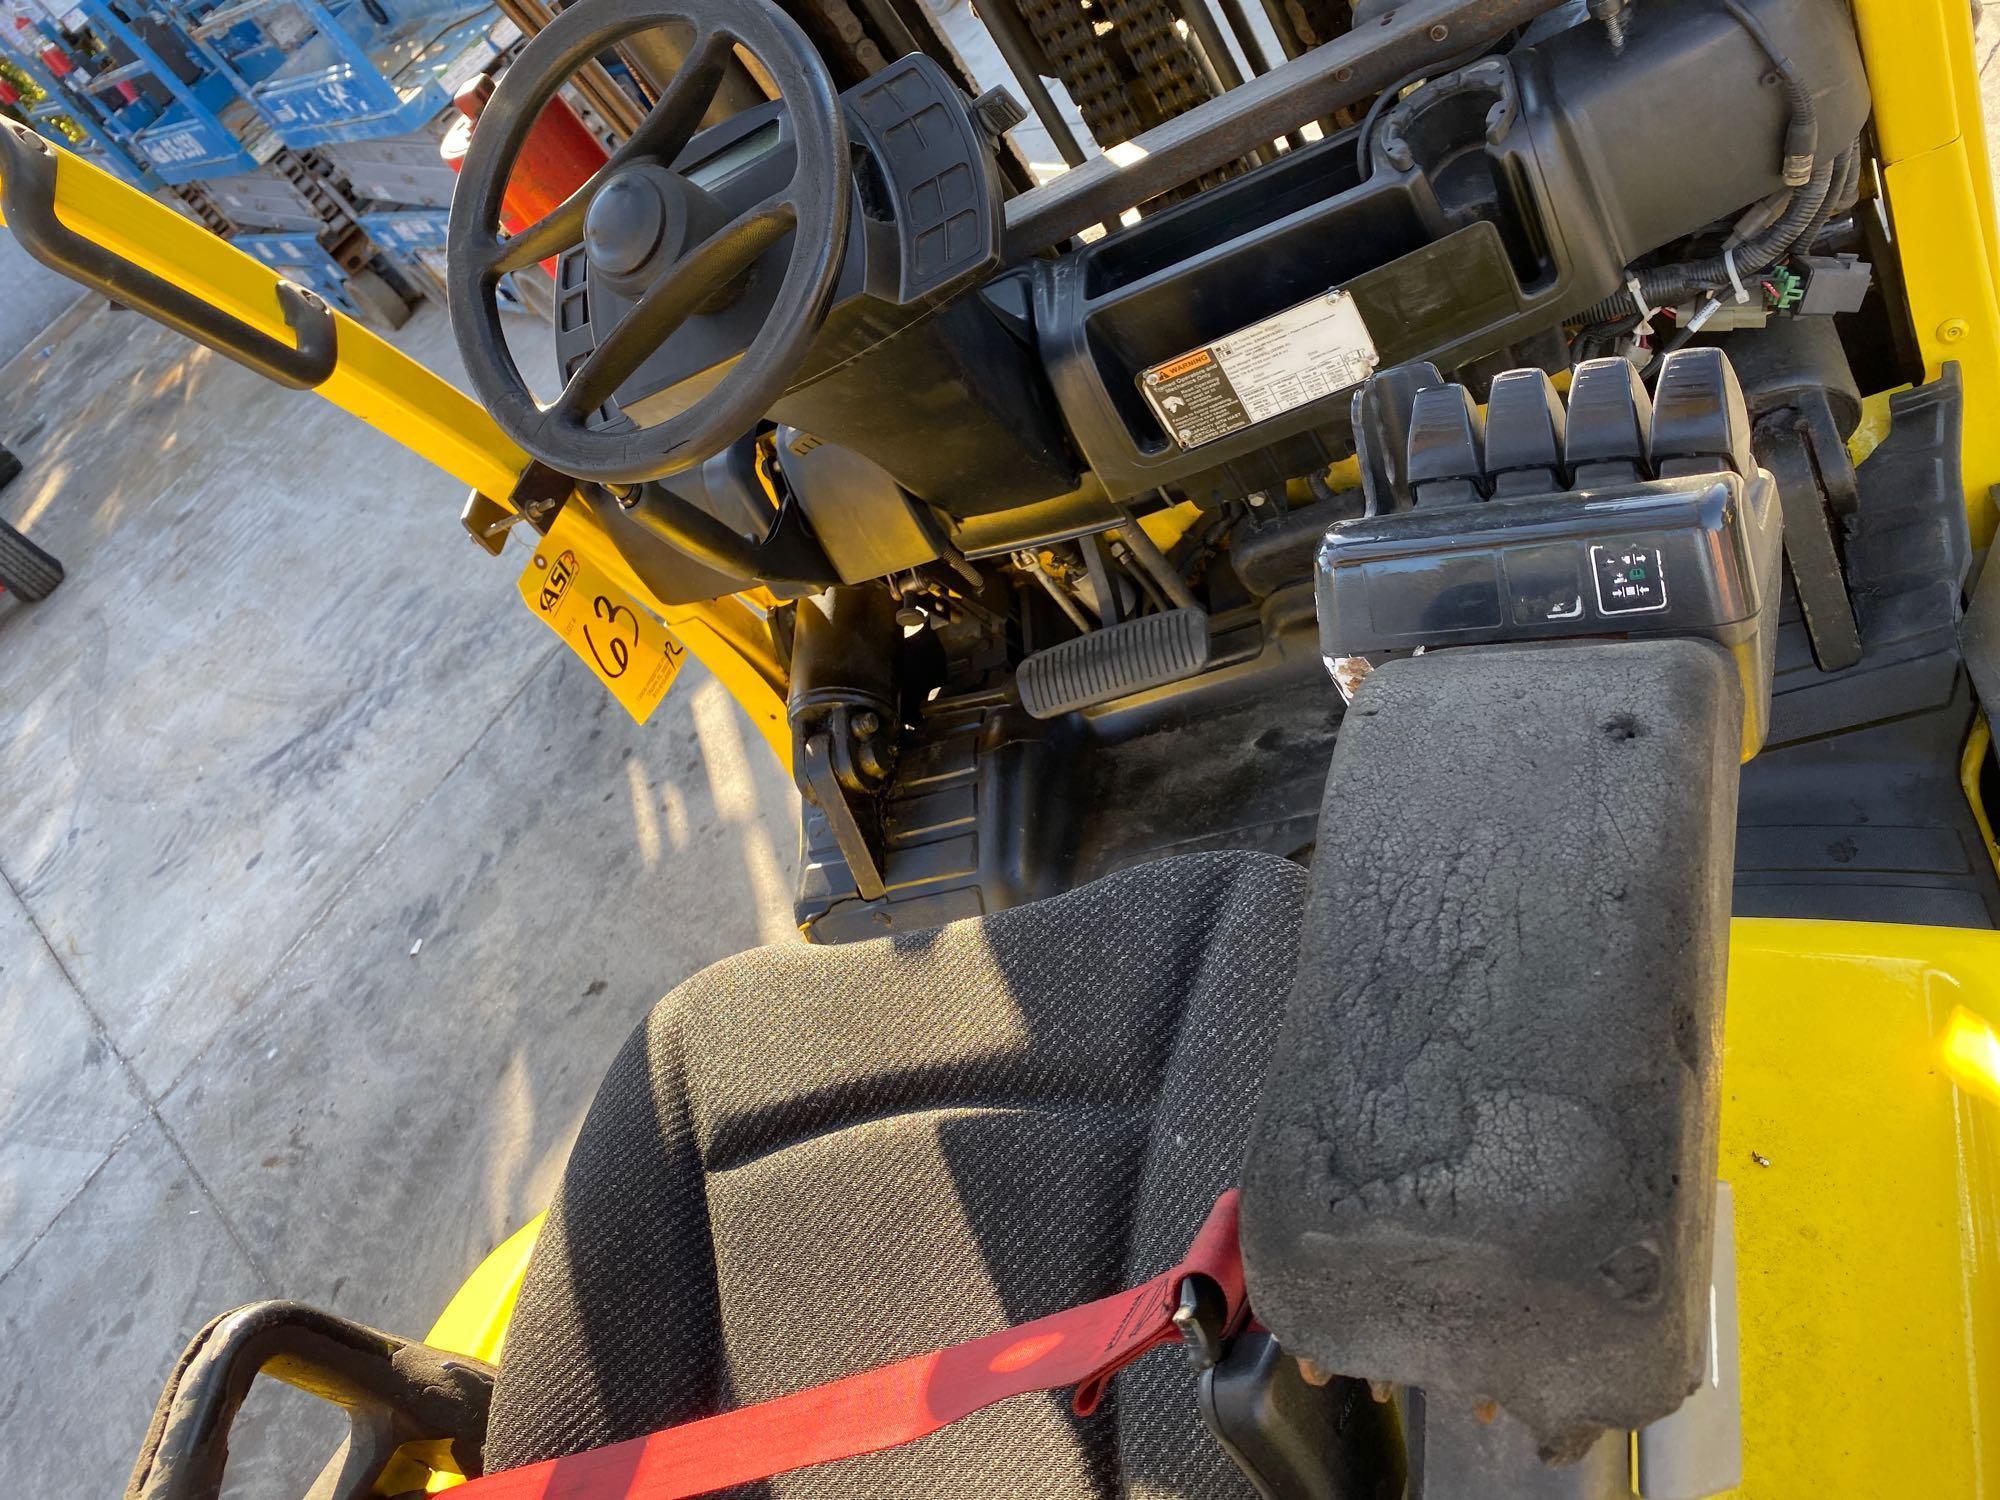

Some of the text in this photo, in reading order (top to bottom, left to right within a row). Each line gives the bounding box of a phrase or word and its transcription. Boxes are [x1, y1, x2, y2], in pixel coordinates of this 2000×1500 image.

[1168, 354, 1209, 373] WARNING
[1175, 369, 1206, 383] Operators
[1196, 372, 1211, 381] Only
[583, 595, 639, 678] 63
